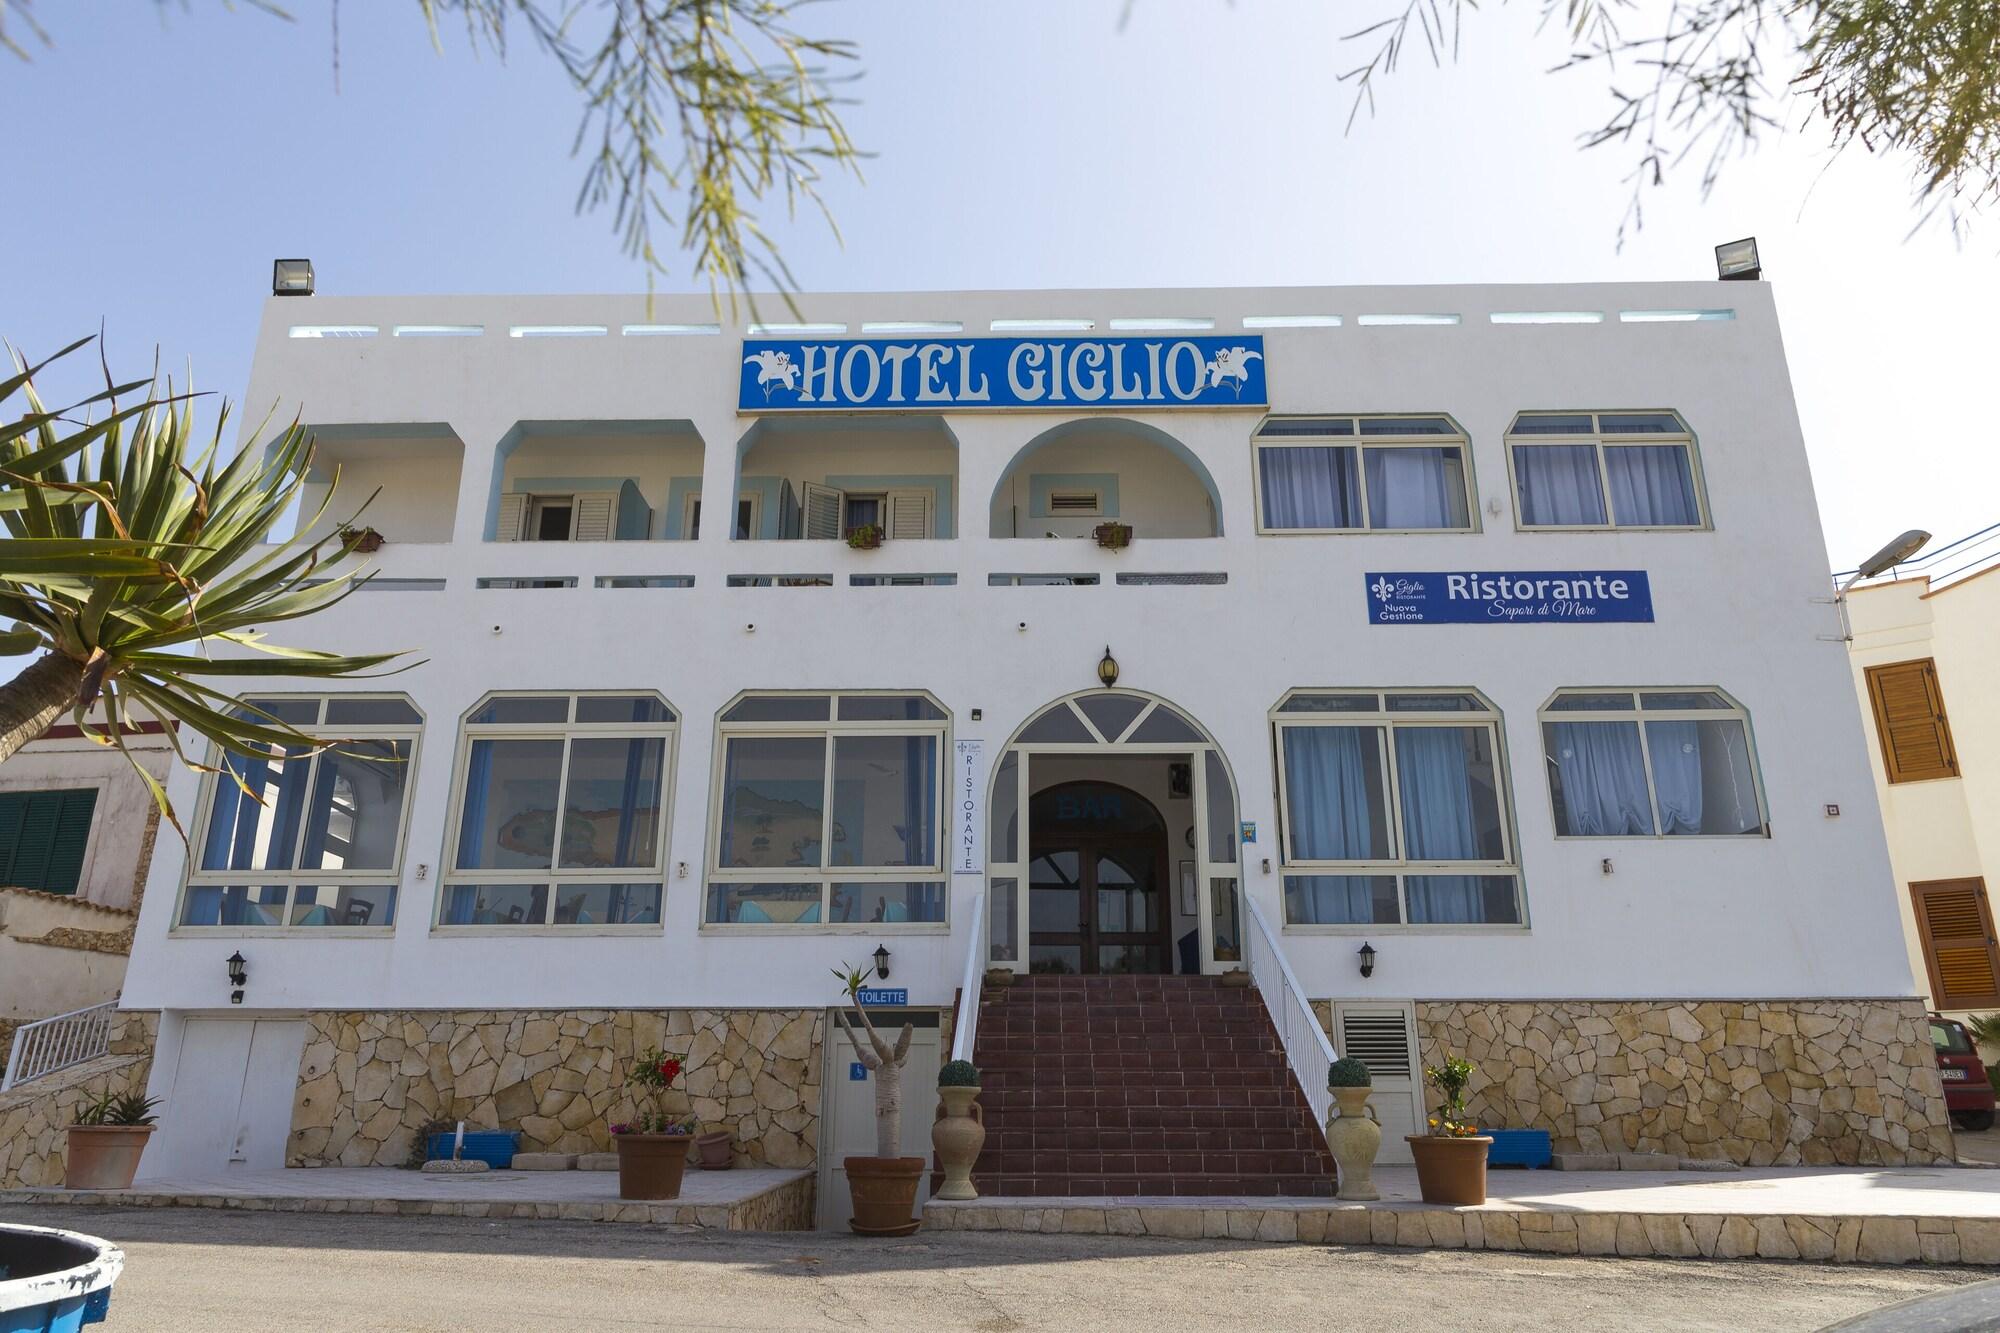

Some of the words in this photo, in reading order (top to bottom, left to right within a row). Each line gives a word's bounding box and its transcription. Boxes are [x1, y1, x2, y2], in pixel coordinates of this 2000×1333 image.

[798, 344, 991, 403] HOTEL
[1007, 341, 1206, 400] GIGLIO
[1446, 573, 1629, 600] Ristorante
[1380, 611, 1423, 620] Gestione
[1385, 604, 1417, 612] Nuova
[1487, 600, 1535, 619] Sapori
[1537, 603, 1550, 616] di
[1552, 600, 1596, 616] Mare
[964, 755, 974, 869] RISTORANTE
[1056, 794, 1121, 819] BAR
[860, 991, 905, 1003] TOILETTE
